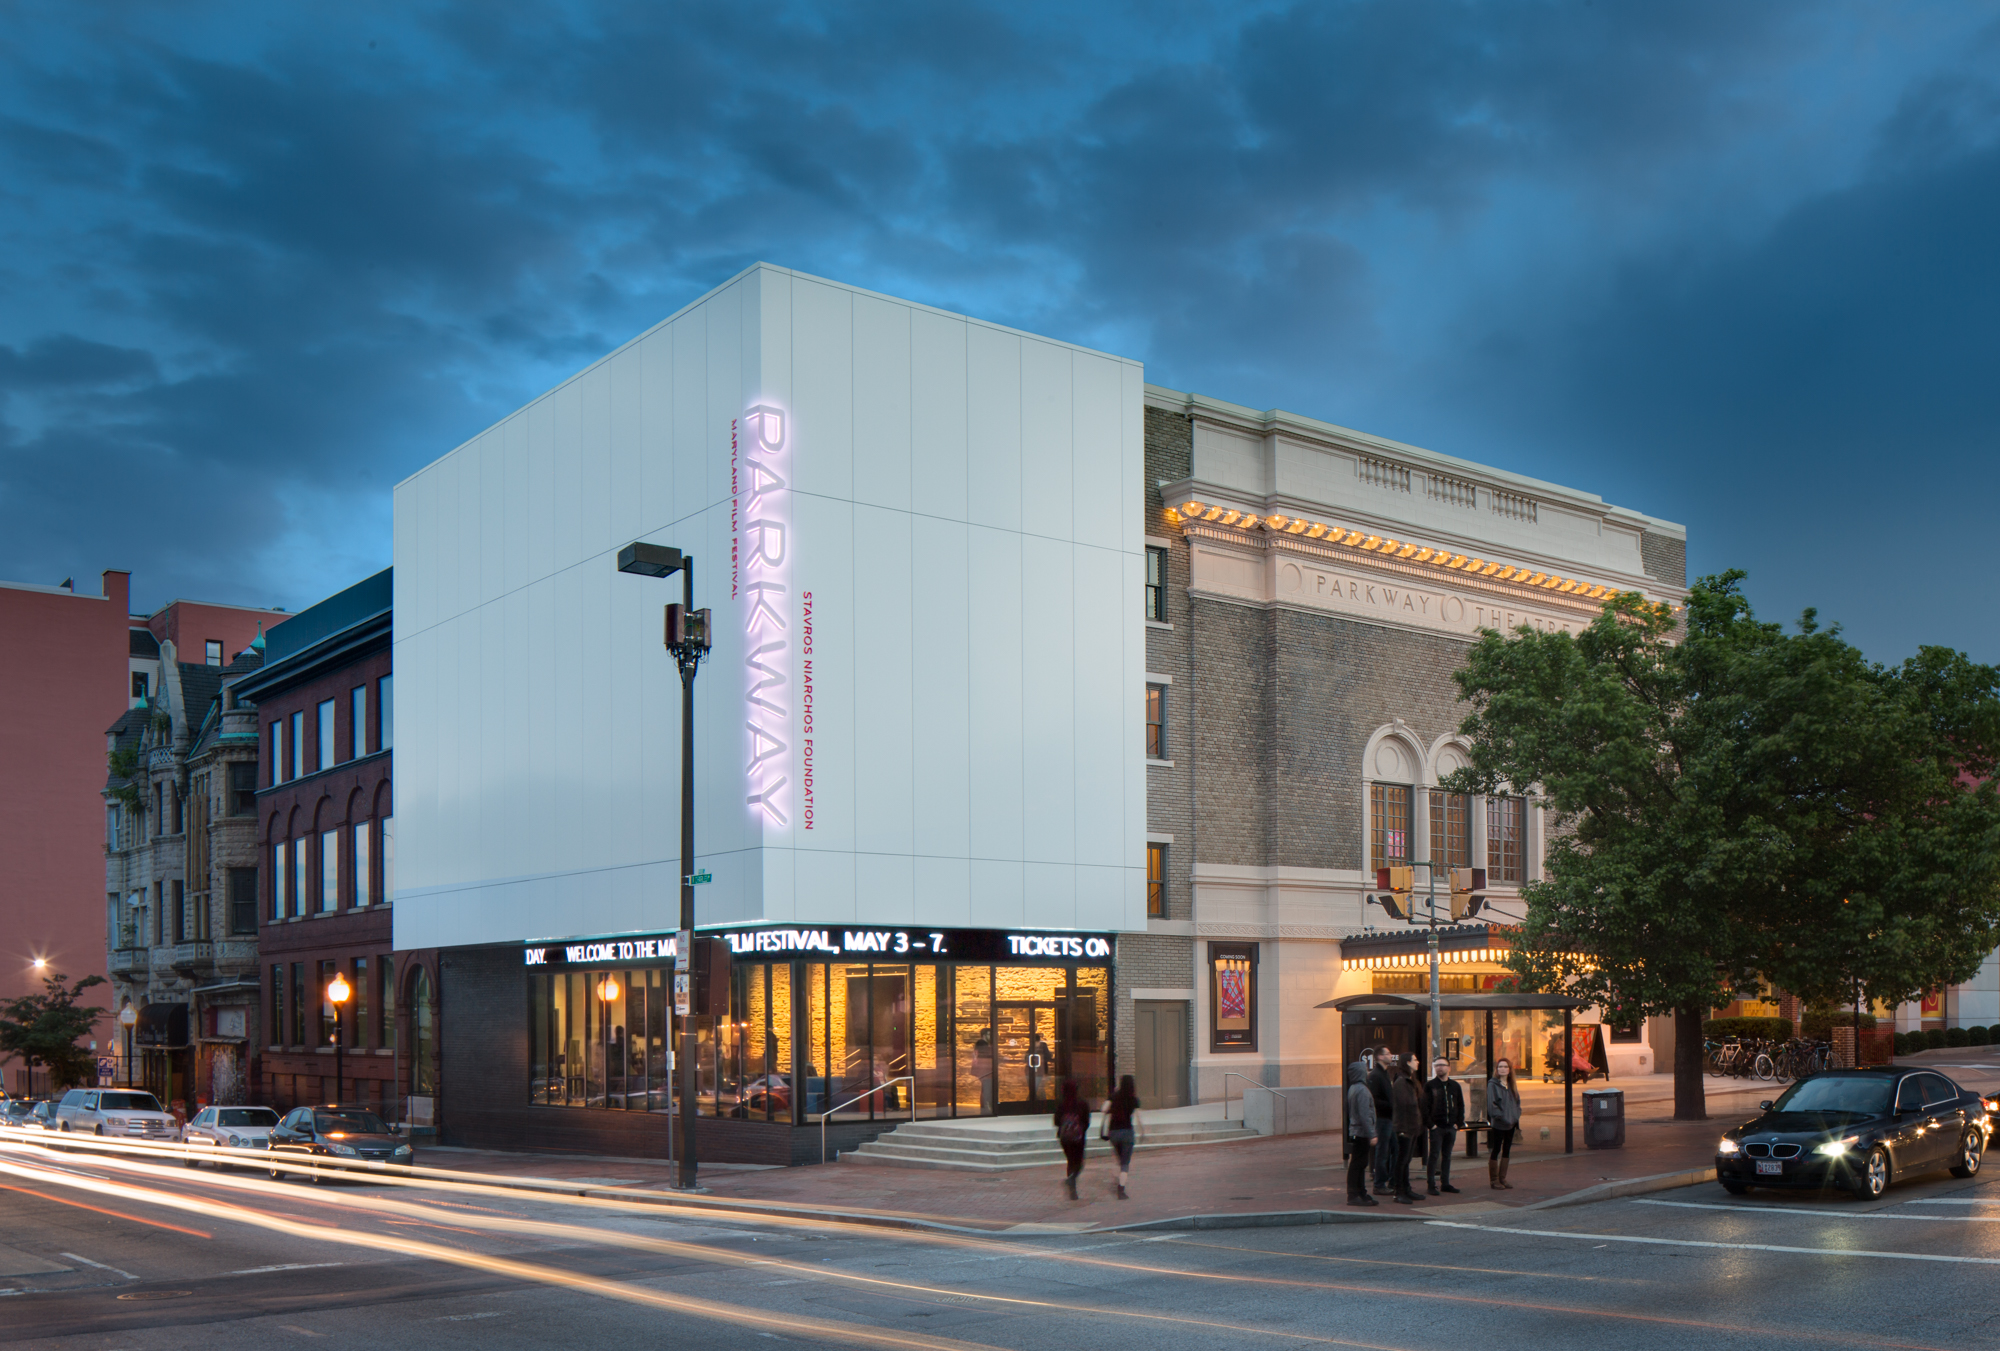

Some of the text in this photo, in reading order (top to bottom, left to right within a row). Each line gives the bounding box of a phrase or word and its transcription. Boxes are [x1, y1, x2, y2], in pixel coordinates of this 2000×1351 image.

[731, 537, 739, 600] FESTIVAL
[1316, 575, 1431, 614] PARKWAY
[744, 404, 787, 826] PARKWAY
[803, 591, 814, 830] STAVROS NIARCHOS FOUNDATION
[526, 948, 548, 965] DAY.
[566, 943, 617, 962] WELCOME
[618, 941, 633, 960] TO
[634, 940, 657, 958] THE
[756, 930, 840, 954] FESTIVAL,
[844, 931, 891, 951] MAY
[894, 932, 909, 952] 3
[929, 933, 948, 952] 7.
[1007, 935, 1083, 957] TICKETS
[1084, 937, 1110, 957] ON
